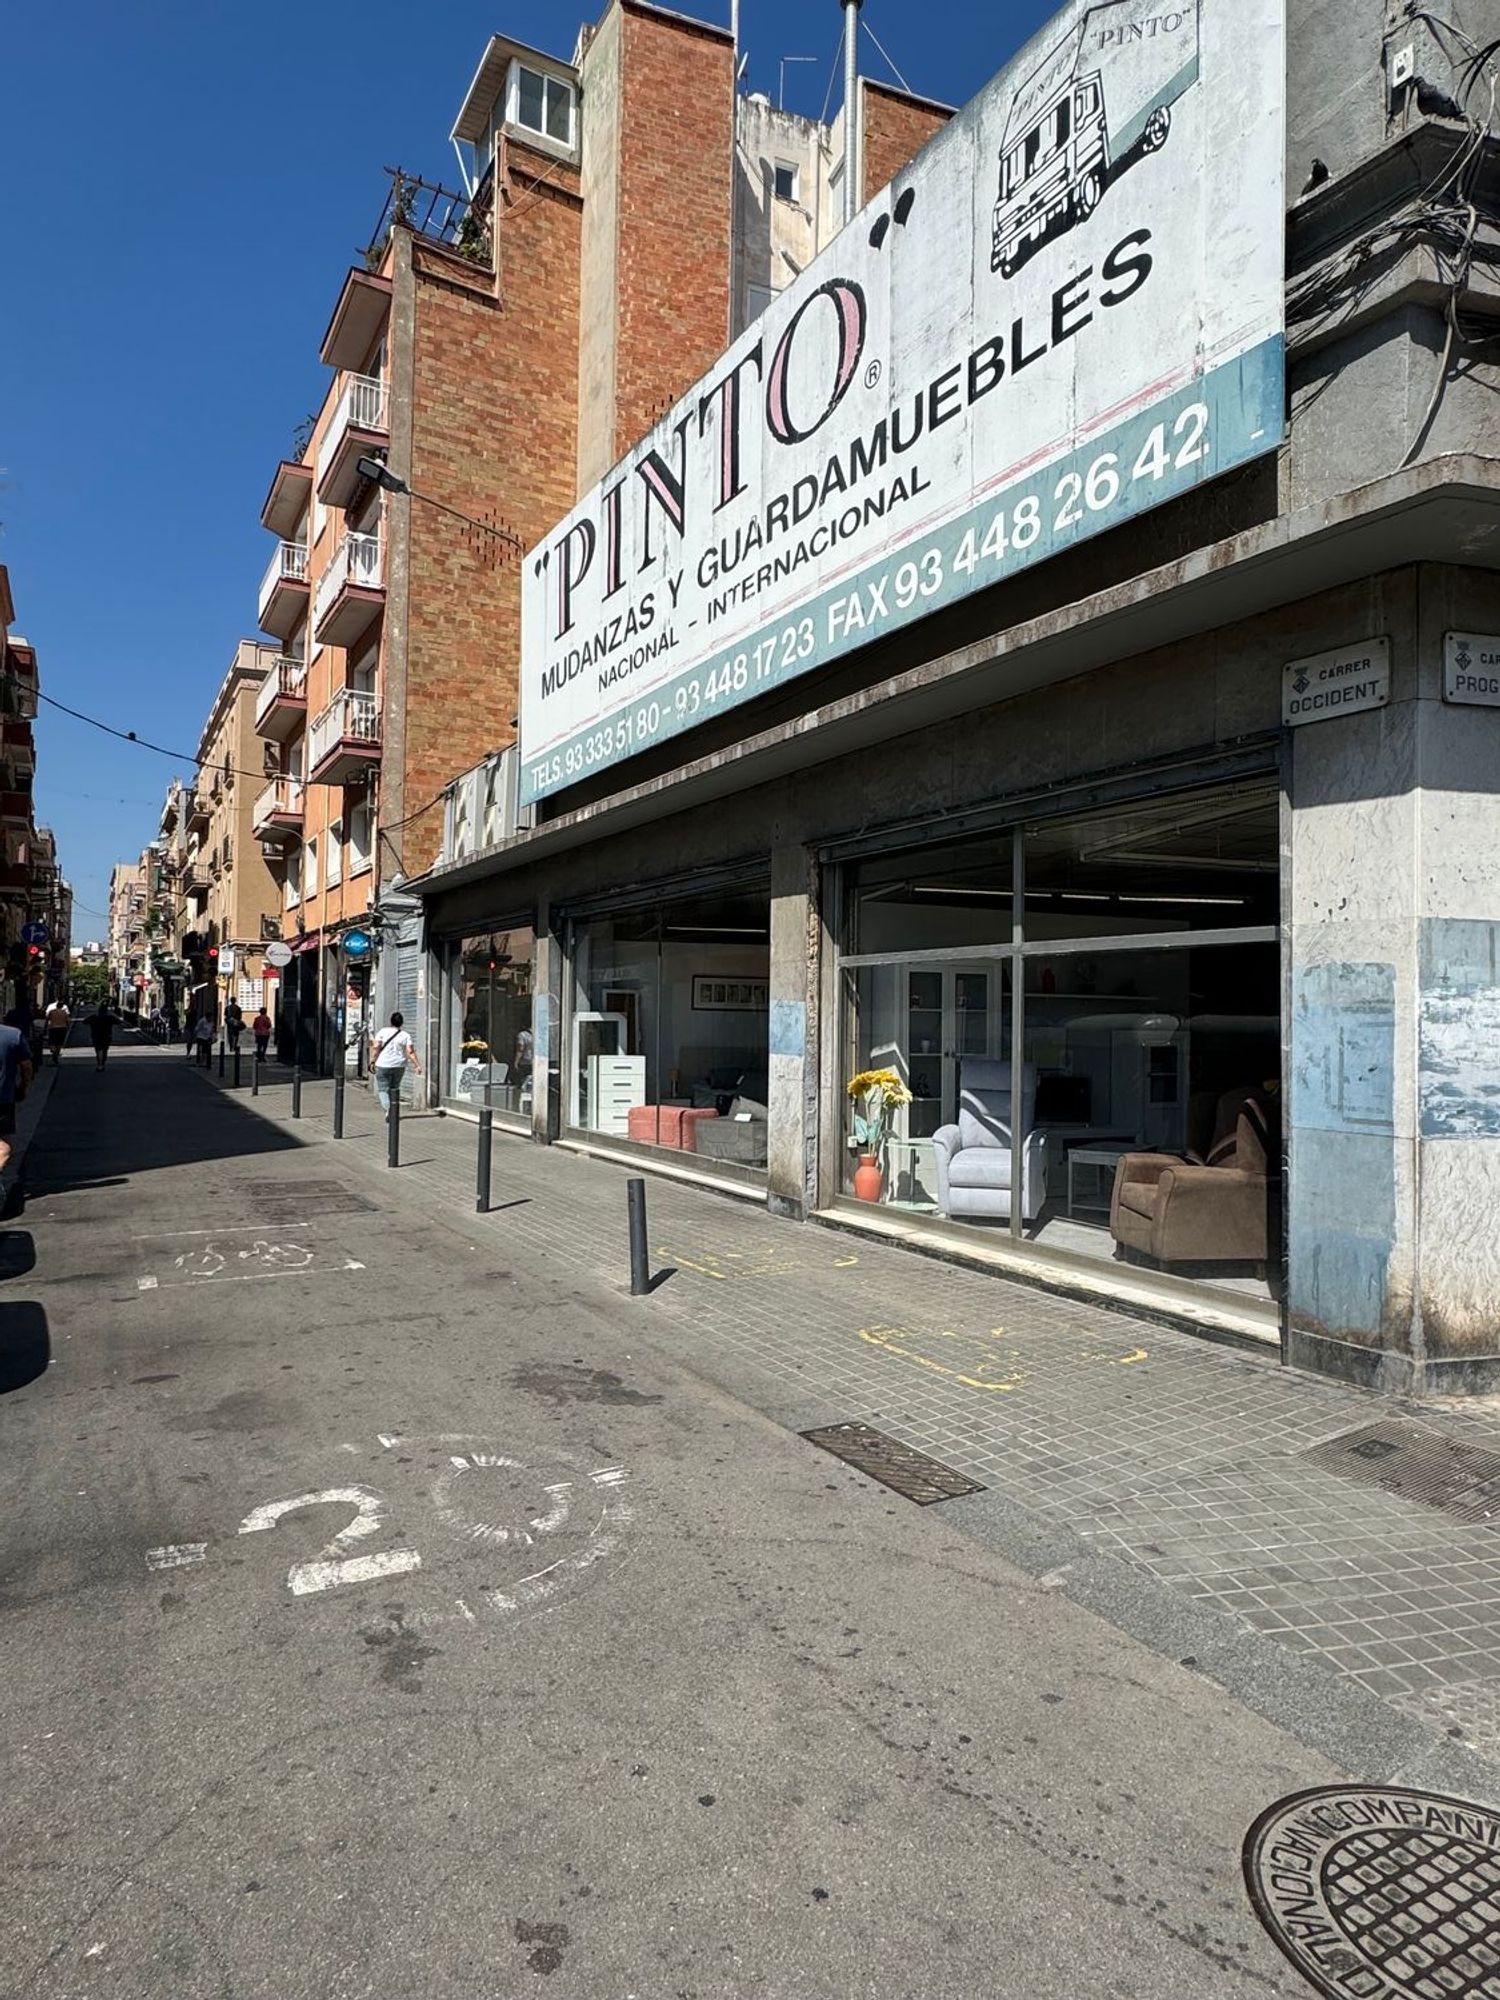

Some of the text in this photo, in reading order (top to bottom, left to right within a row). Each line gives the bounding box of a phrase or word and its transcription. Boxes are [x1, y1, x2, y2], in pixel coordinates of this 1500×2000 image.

[541, 228, 1153, 699] MUDANZAS Y GUARDAMUEBLES
[531, 760, 564, 792] TELS.
[565, 743, 583, 775] 93
[585, 727, 613, 765] 333
[616, 716, 633, 750] 51
[636, 702, 659, 741] 80
[675, 682, 701, 721] 93
[705, 653, 748, 703] 448
[753, 636, 777, 679] 17
[782, 617, 815, 666] 23
[827, 575, 890, 645] FAX
[894, 548, 944, 608] 93
[953, 496, 1041, 575] 448
[1053, 452, 1120, 532] 26
[1132, 402, 1211, 481] 42
[599, 627, 680, 692] NACIONAL
[707, 466, 931, 624] INTERNACIONAL
[1319, 658, 1371, 681] CARRER
[1290, 680, 1380, 714] OCCIDENT
[1270, 1819, 1342, 1965] NACIONAL
